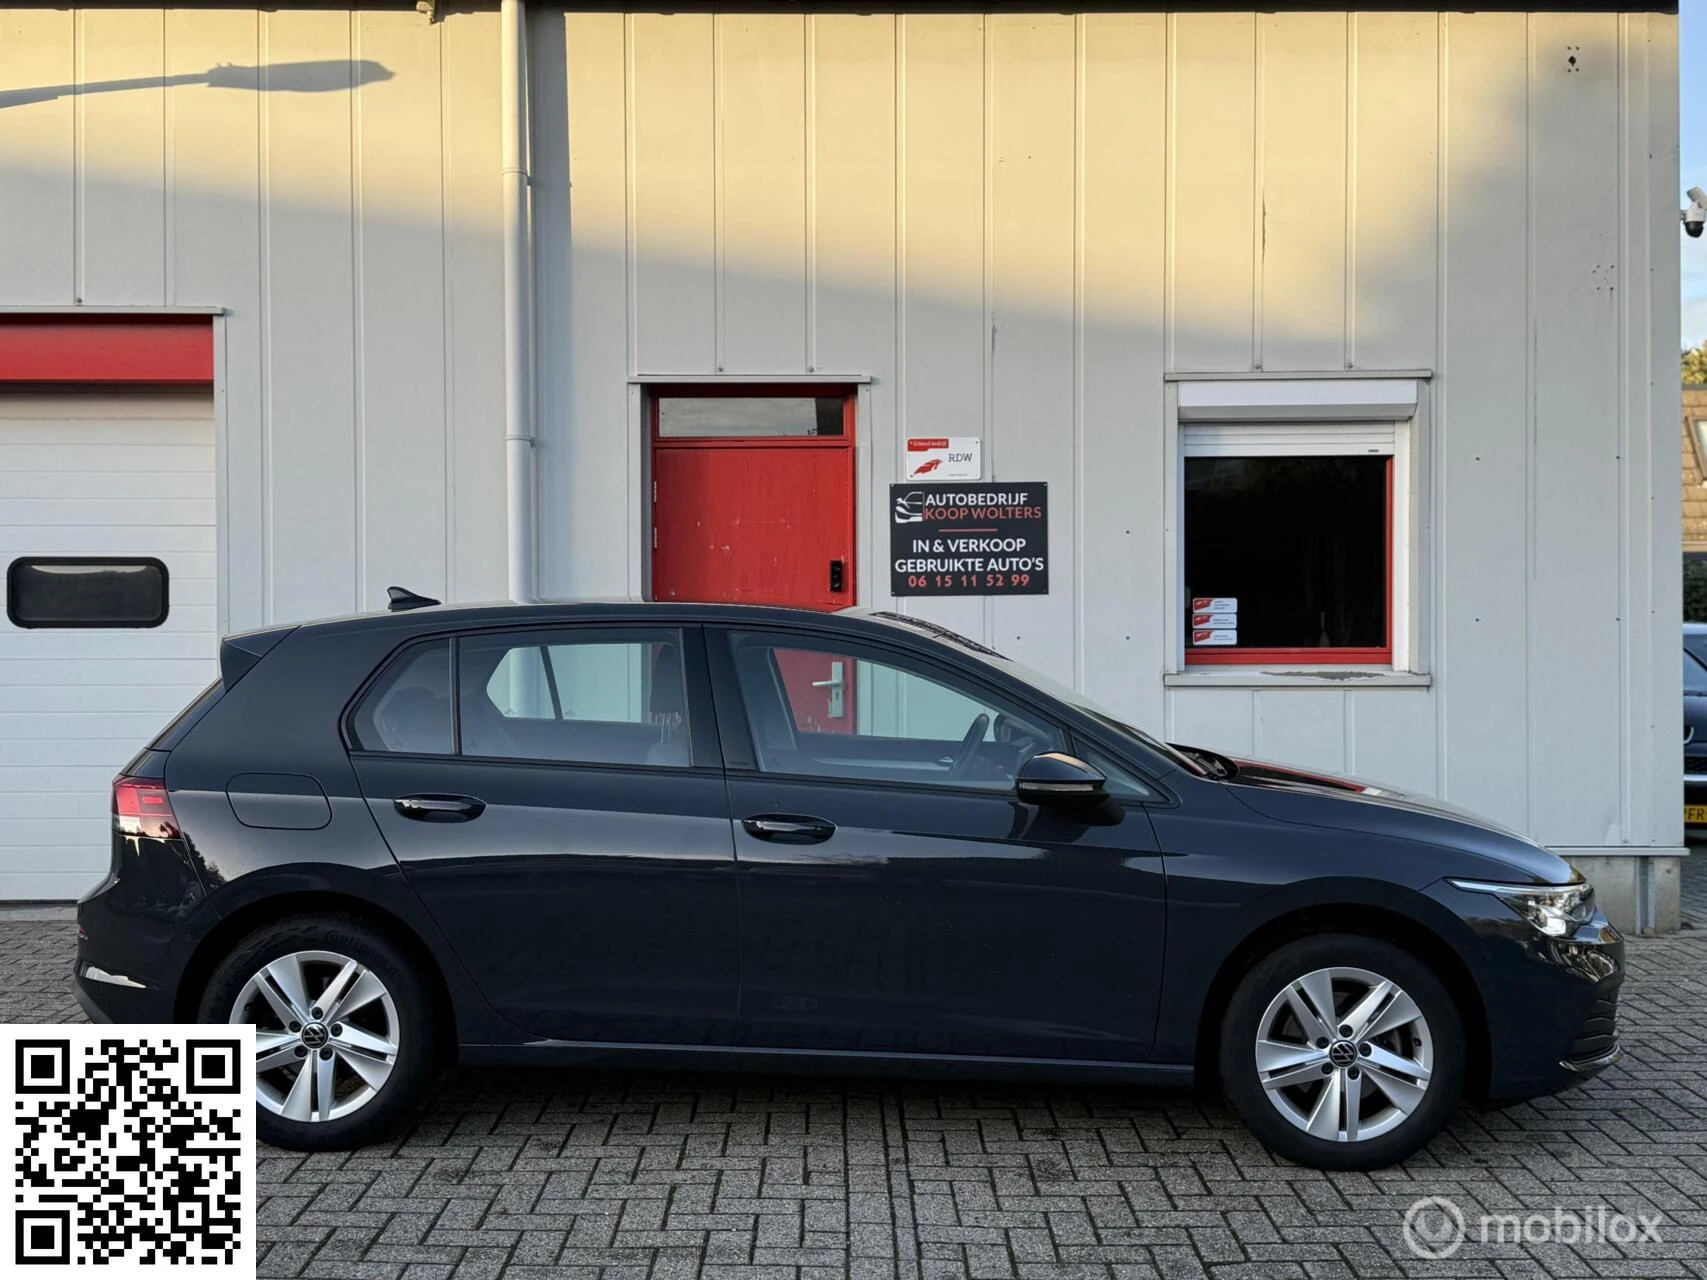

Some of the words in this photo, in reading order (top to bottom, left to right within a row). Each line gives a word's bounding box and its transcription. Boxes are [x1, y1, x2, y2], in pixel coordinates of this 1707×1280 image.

[948, 453, 972, 462] RDW
[925, 493, 1028, 506] AUTOBEDRIJF
[925, 507, 969, 520] KOOP
[971, 506, 1042, 520] WOLTERS
[913, 539, 929, 553] IN
[933, 539, 945, 553] &
[947, 538, 1026, 552] VERKOOP
[895, 558, 984, 573] GEBRUIKTE
[986, 557, 1044, 572] AUTO'S
[908, 575, 927, 587] 06
[935, 575, 952, 587] 15
[961, 575, 977, 587] 11
[986, 574, 1004, 587] 52
[1011, 574, 1030, 587] 99
